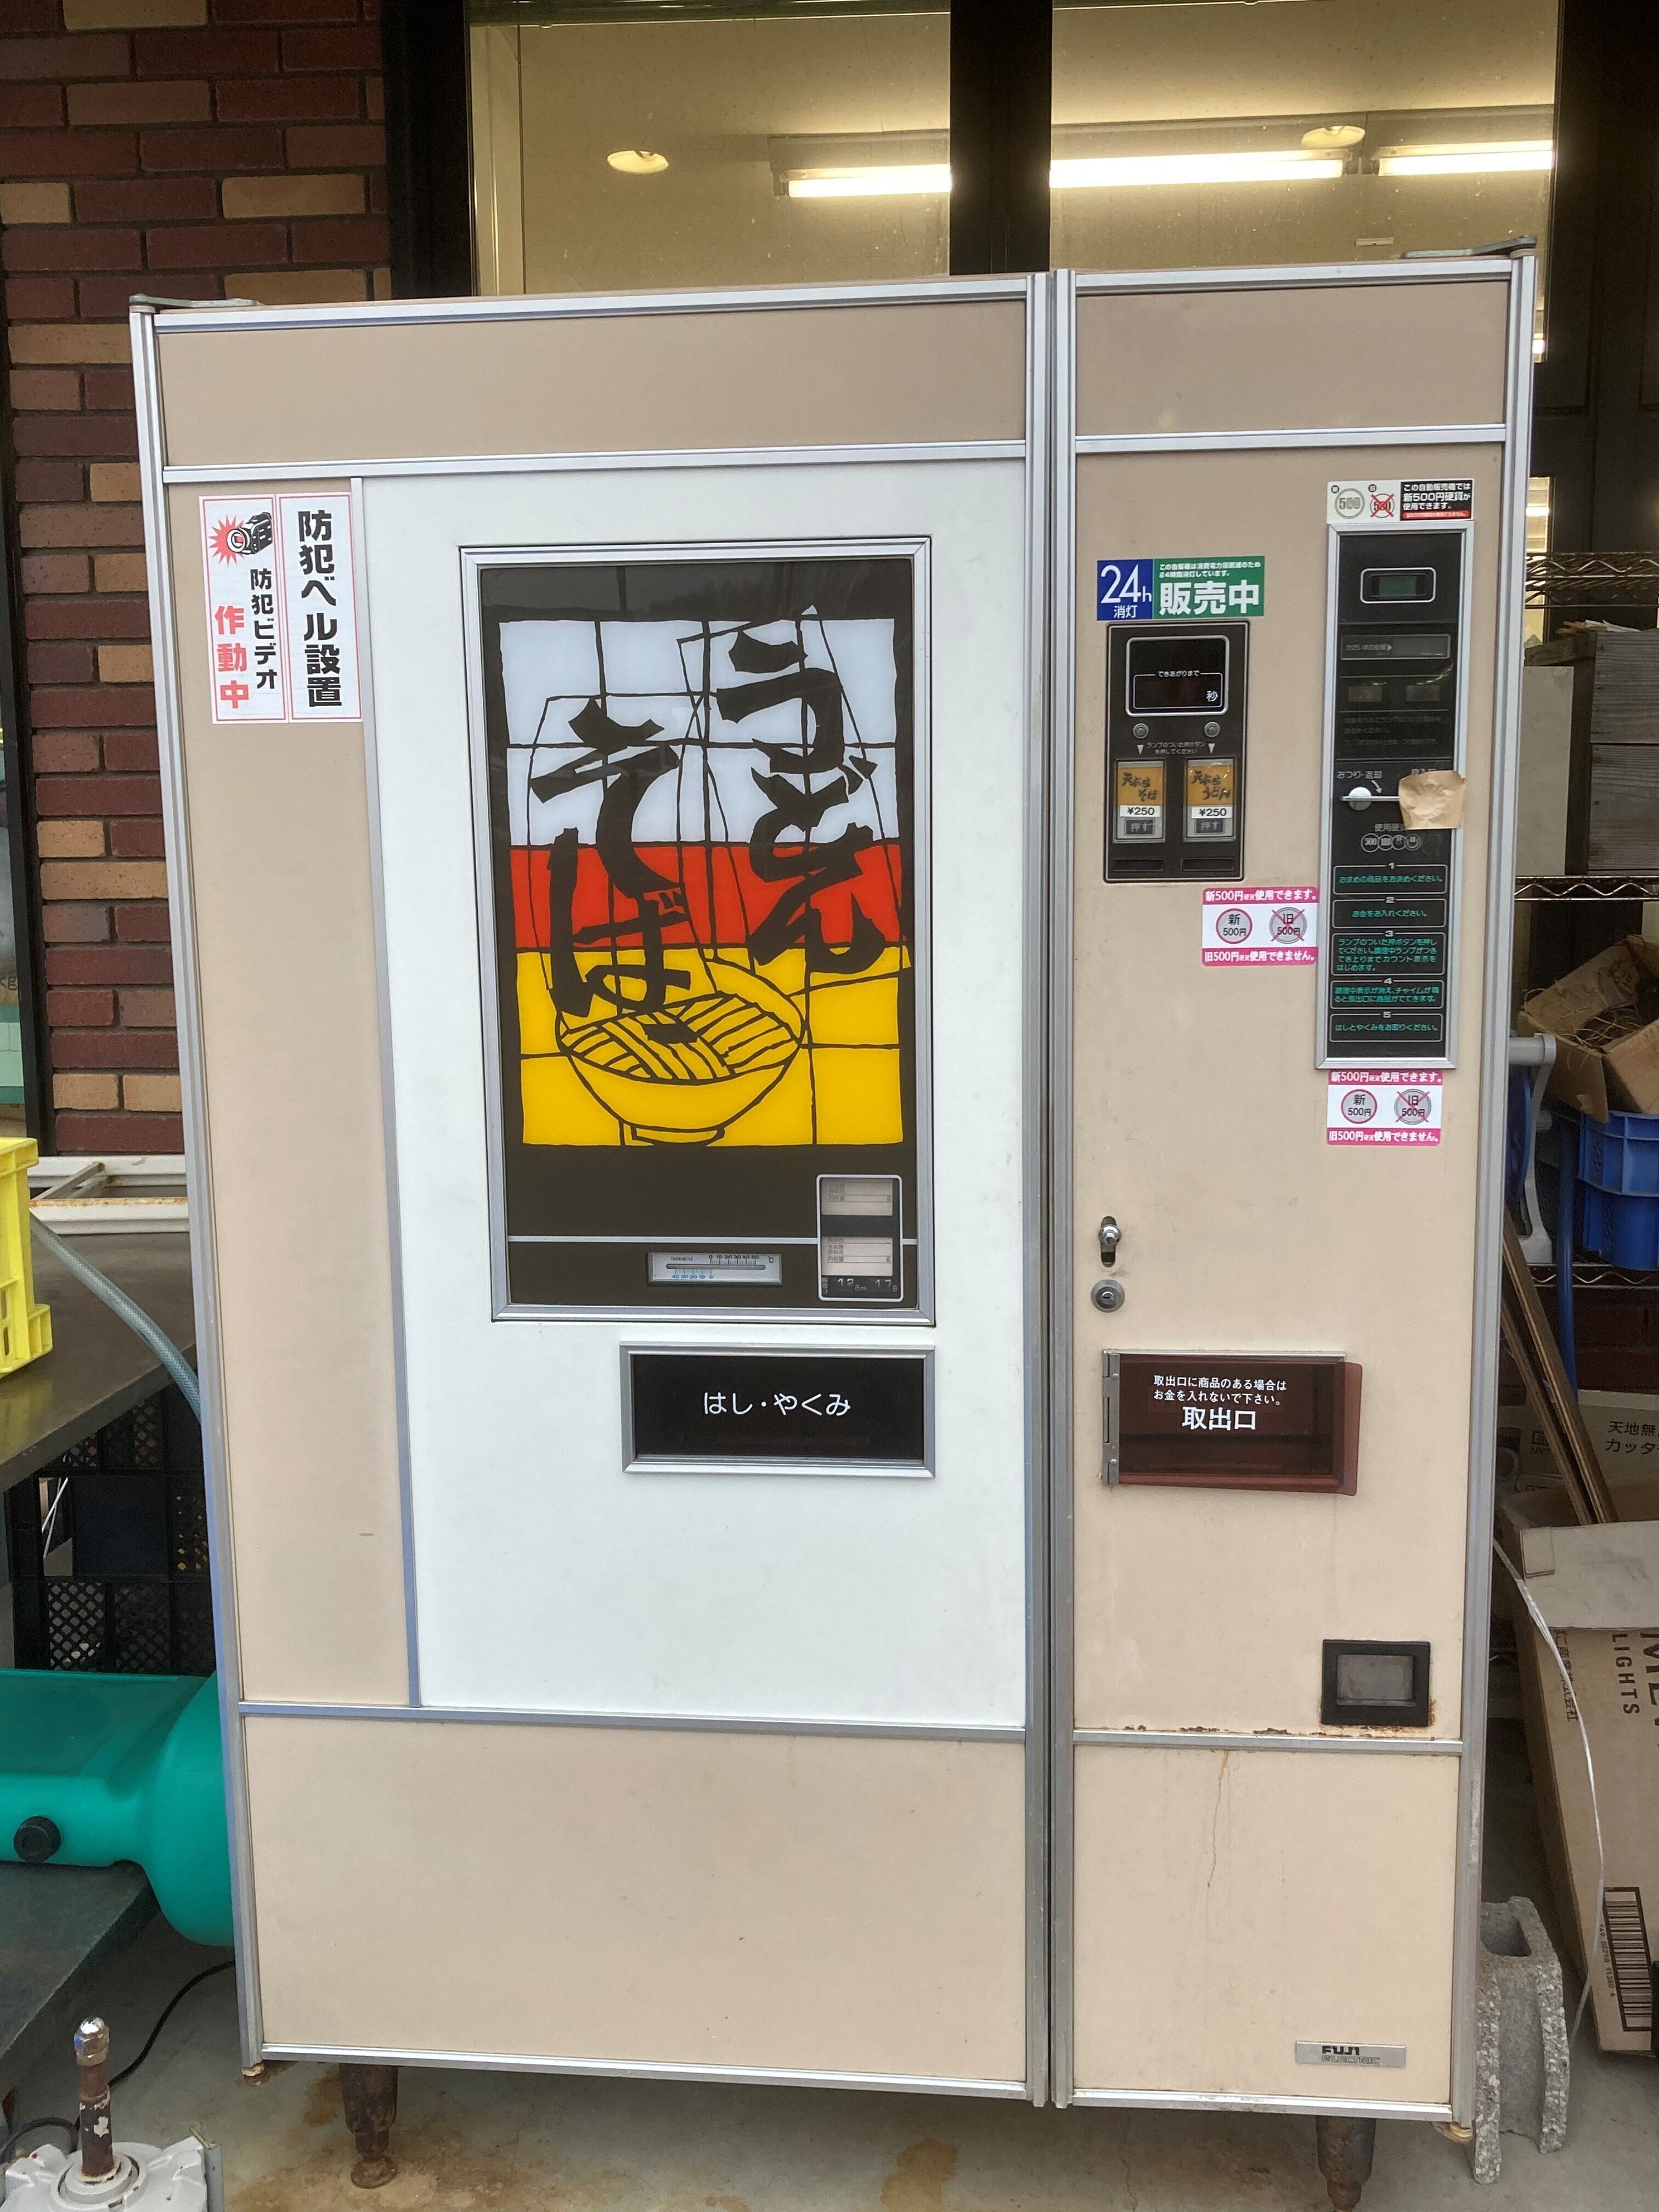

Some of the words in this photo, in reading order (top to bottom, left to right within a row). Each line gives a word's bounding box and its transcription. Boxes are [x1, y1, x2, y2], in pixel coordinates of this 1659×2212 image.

[1339, 496, 1361, 510] 500
[1403, 501, 1452, 511] 使用できます。
[1100, 563, 1152, 603] 24h
[1159, 579, 1260, 616] 販売中
[297, 510, 342, 708] 防犯ベル設置
[1113, 605, 1138, 619] 消灯
[250, 568, 278, 689] 防犯ビデオ
[214, 605, 250, 709] 作動中
[1158, 670, 1200, 678] できあがりまで
[1206, 690, 1218, 702] 秒
[1127, 806, 1155, 816] ¥250
[1199, 808, 1227, 817] ¥250
[1130, 822, 1151, 832] 押す
[1200, 821, 1220, 831] 押す
[1228, 913, 1241, 926] 新
[1283, 913, 1294, 924] 旧
[1222, 927, 1246, 936] 500円
[1277, 927, 1300, 935] 500円
[1353, 1094, 1365, 1105] 新
[1408, 1095, 1419, 1105] 旧
[1347, 1107, 1372, 1117] 500円
[1401, 1108, 1425, 1117] 500円
[1153, 1374, 1287, 1392] 取出口に商品のある場合は
[1153, 1389, 1281, 1406] お金を入れないで下さい。
[703, 1392, 851, 1416] はし・やくみ
[1182, 1406, 1256, 1431] 取出口
[1607, 1420, 1659, 1437] 天地無
[1605, 1438, 1659, 1454] カッタ
[1611, 1632, 1640, 1715] LIGHTS
[1322, 2045, 1360, 2056] FUJI
[1321, 2054, 1380, 2065] ELECTRIC
